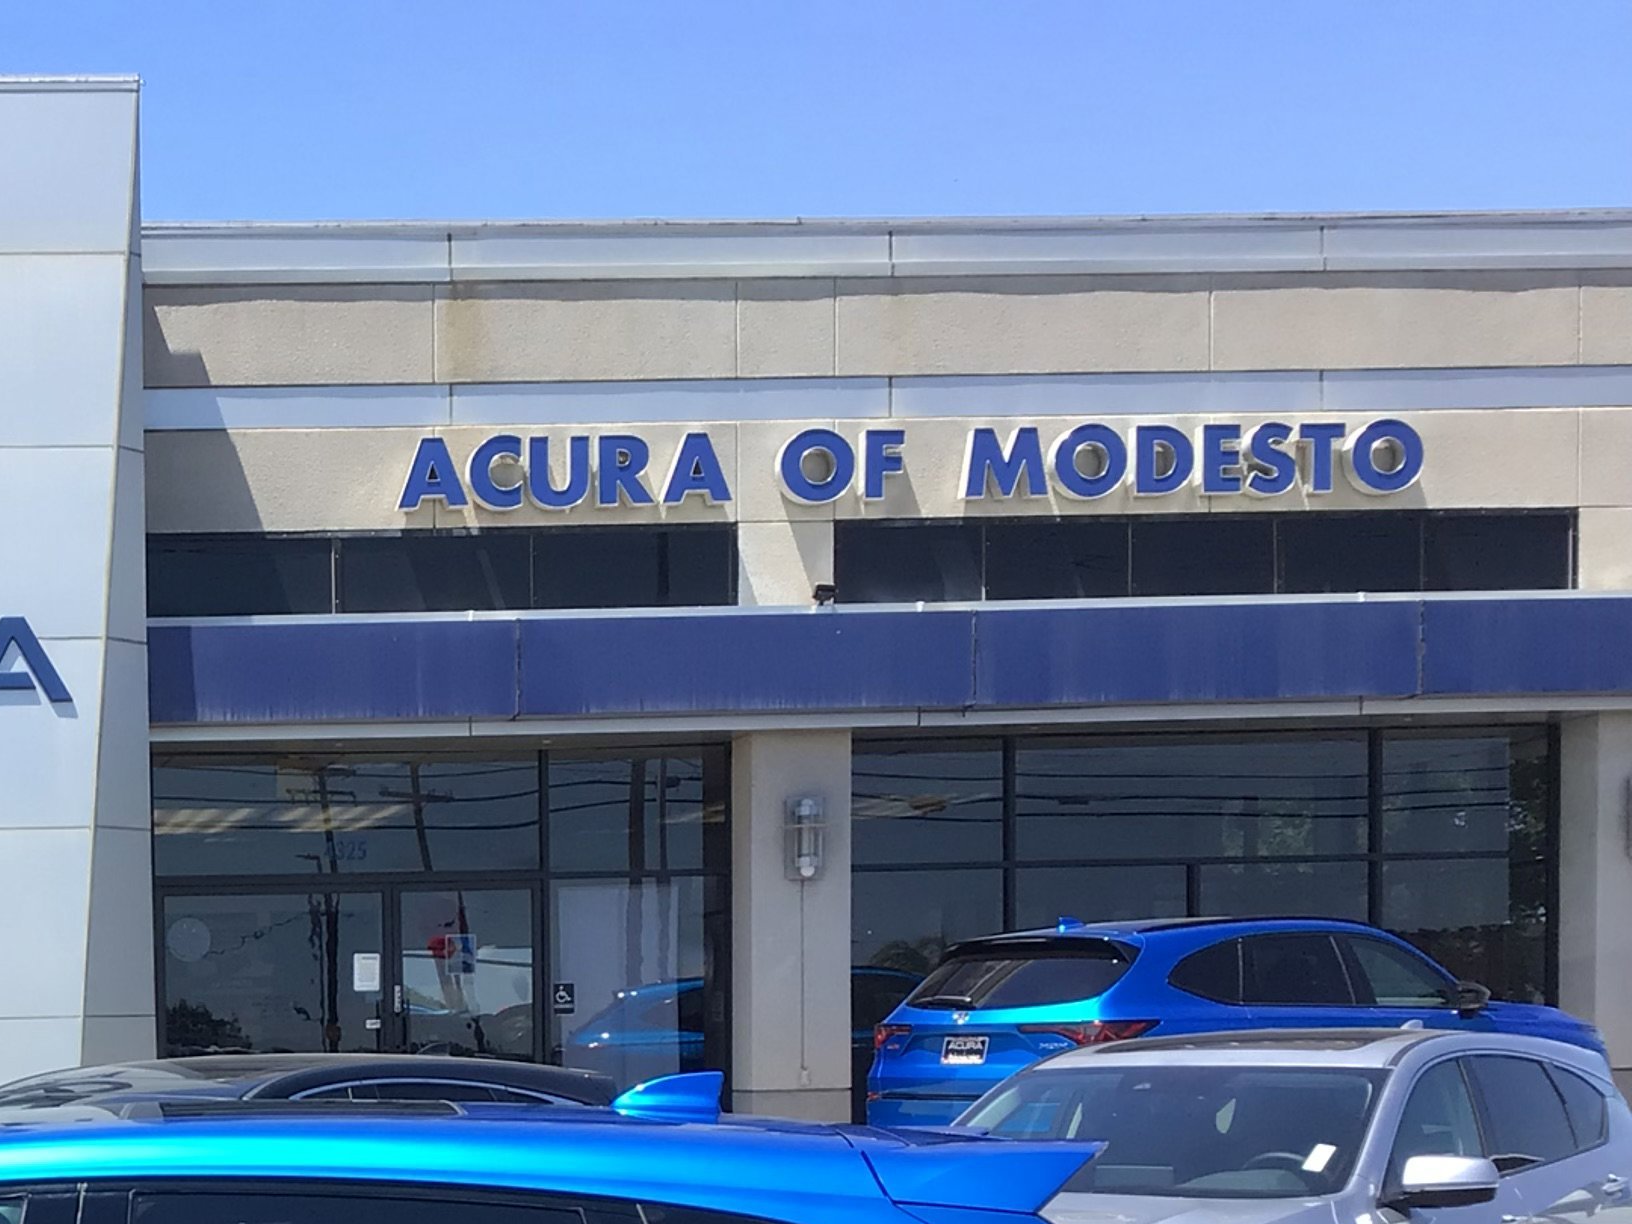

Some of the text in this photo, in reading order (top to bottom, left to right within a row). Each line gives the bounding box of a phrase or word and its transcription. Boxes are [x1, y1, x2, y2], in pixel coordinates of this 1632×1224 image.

[397, 417, 1425, 514] ACURA OF MODESTO
